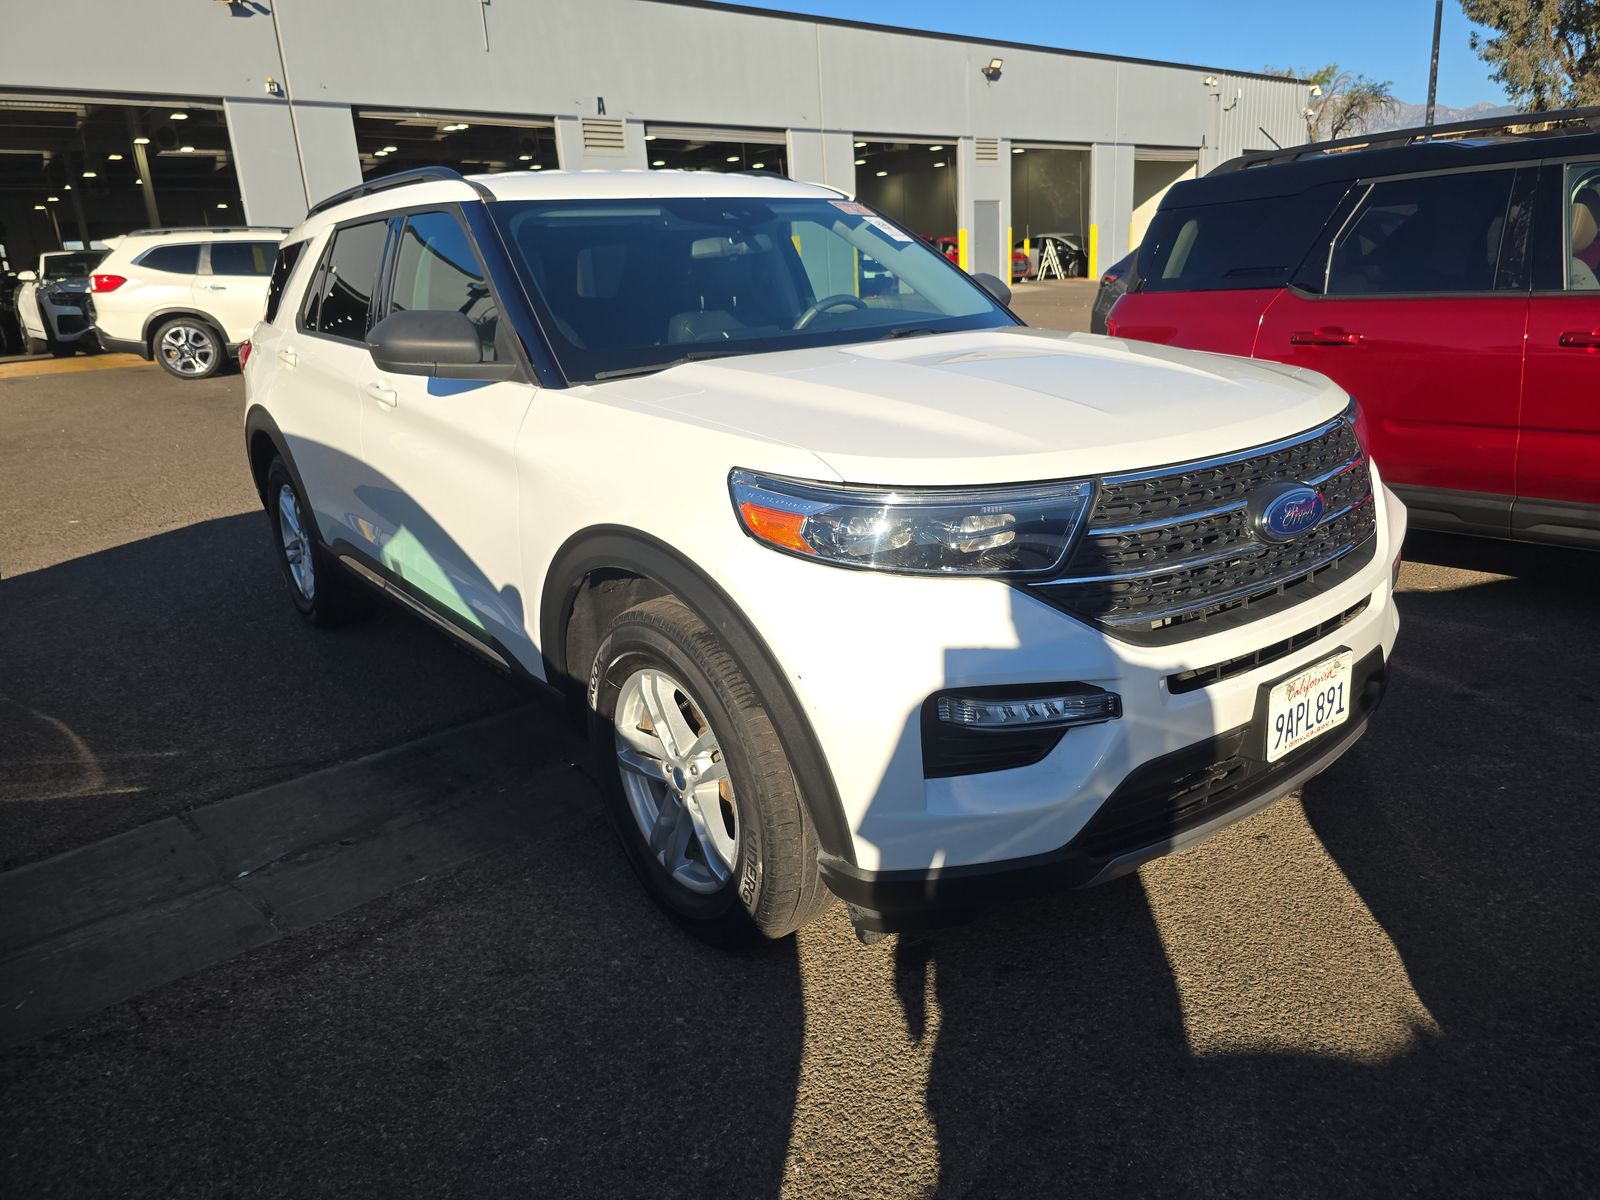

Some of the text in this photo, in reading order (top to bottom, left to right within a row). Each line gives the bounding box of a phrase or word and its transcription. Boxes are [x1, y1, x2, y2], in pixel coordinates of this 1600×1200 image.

[597, 96, 606, 116] A
[1282, 498, 1316, 529] Ford
[1287, 669, 1338, 701] California
[1274, 681, 1345, 750] 9APL891
